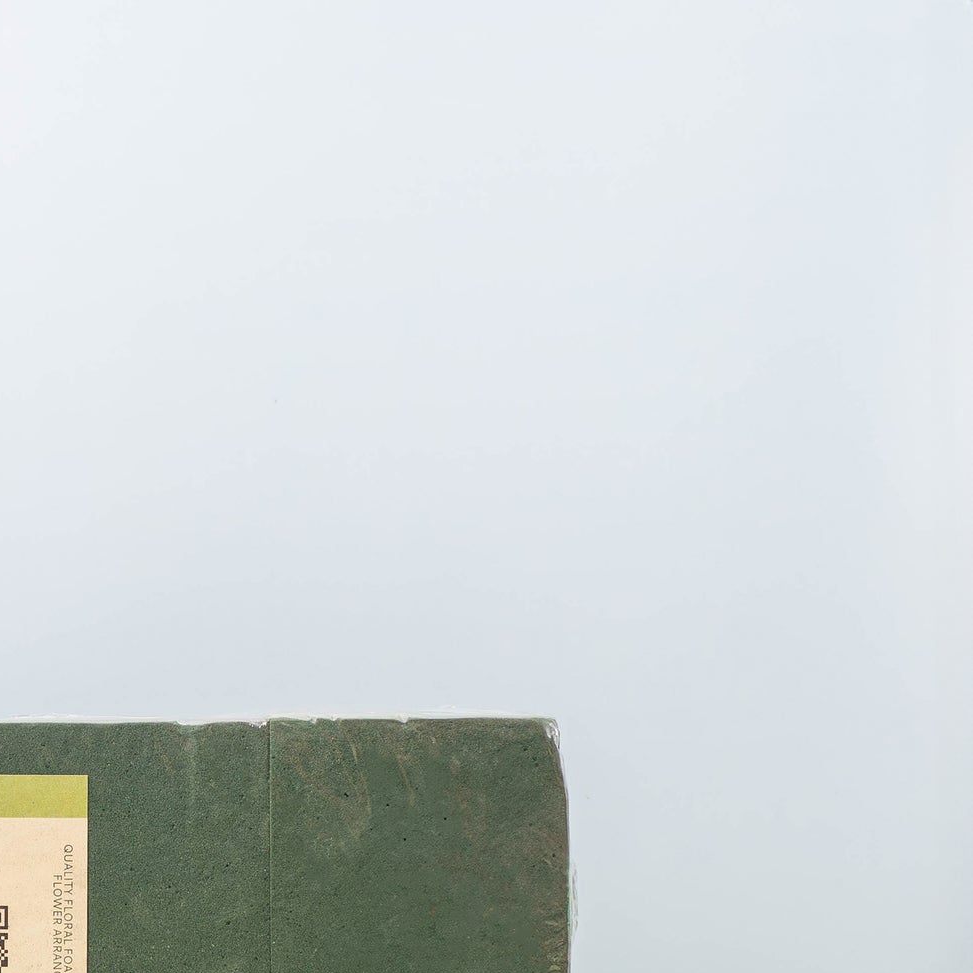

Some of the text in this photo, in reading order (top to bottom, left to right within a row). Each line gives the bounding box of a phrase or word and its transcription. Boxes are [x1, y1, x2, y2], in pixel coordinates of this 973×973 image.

[64, 844, 73, 895] QUALITY
[53, 874, 62, 925] FLOWER
[63, 900, 73, 944] FLORAL
